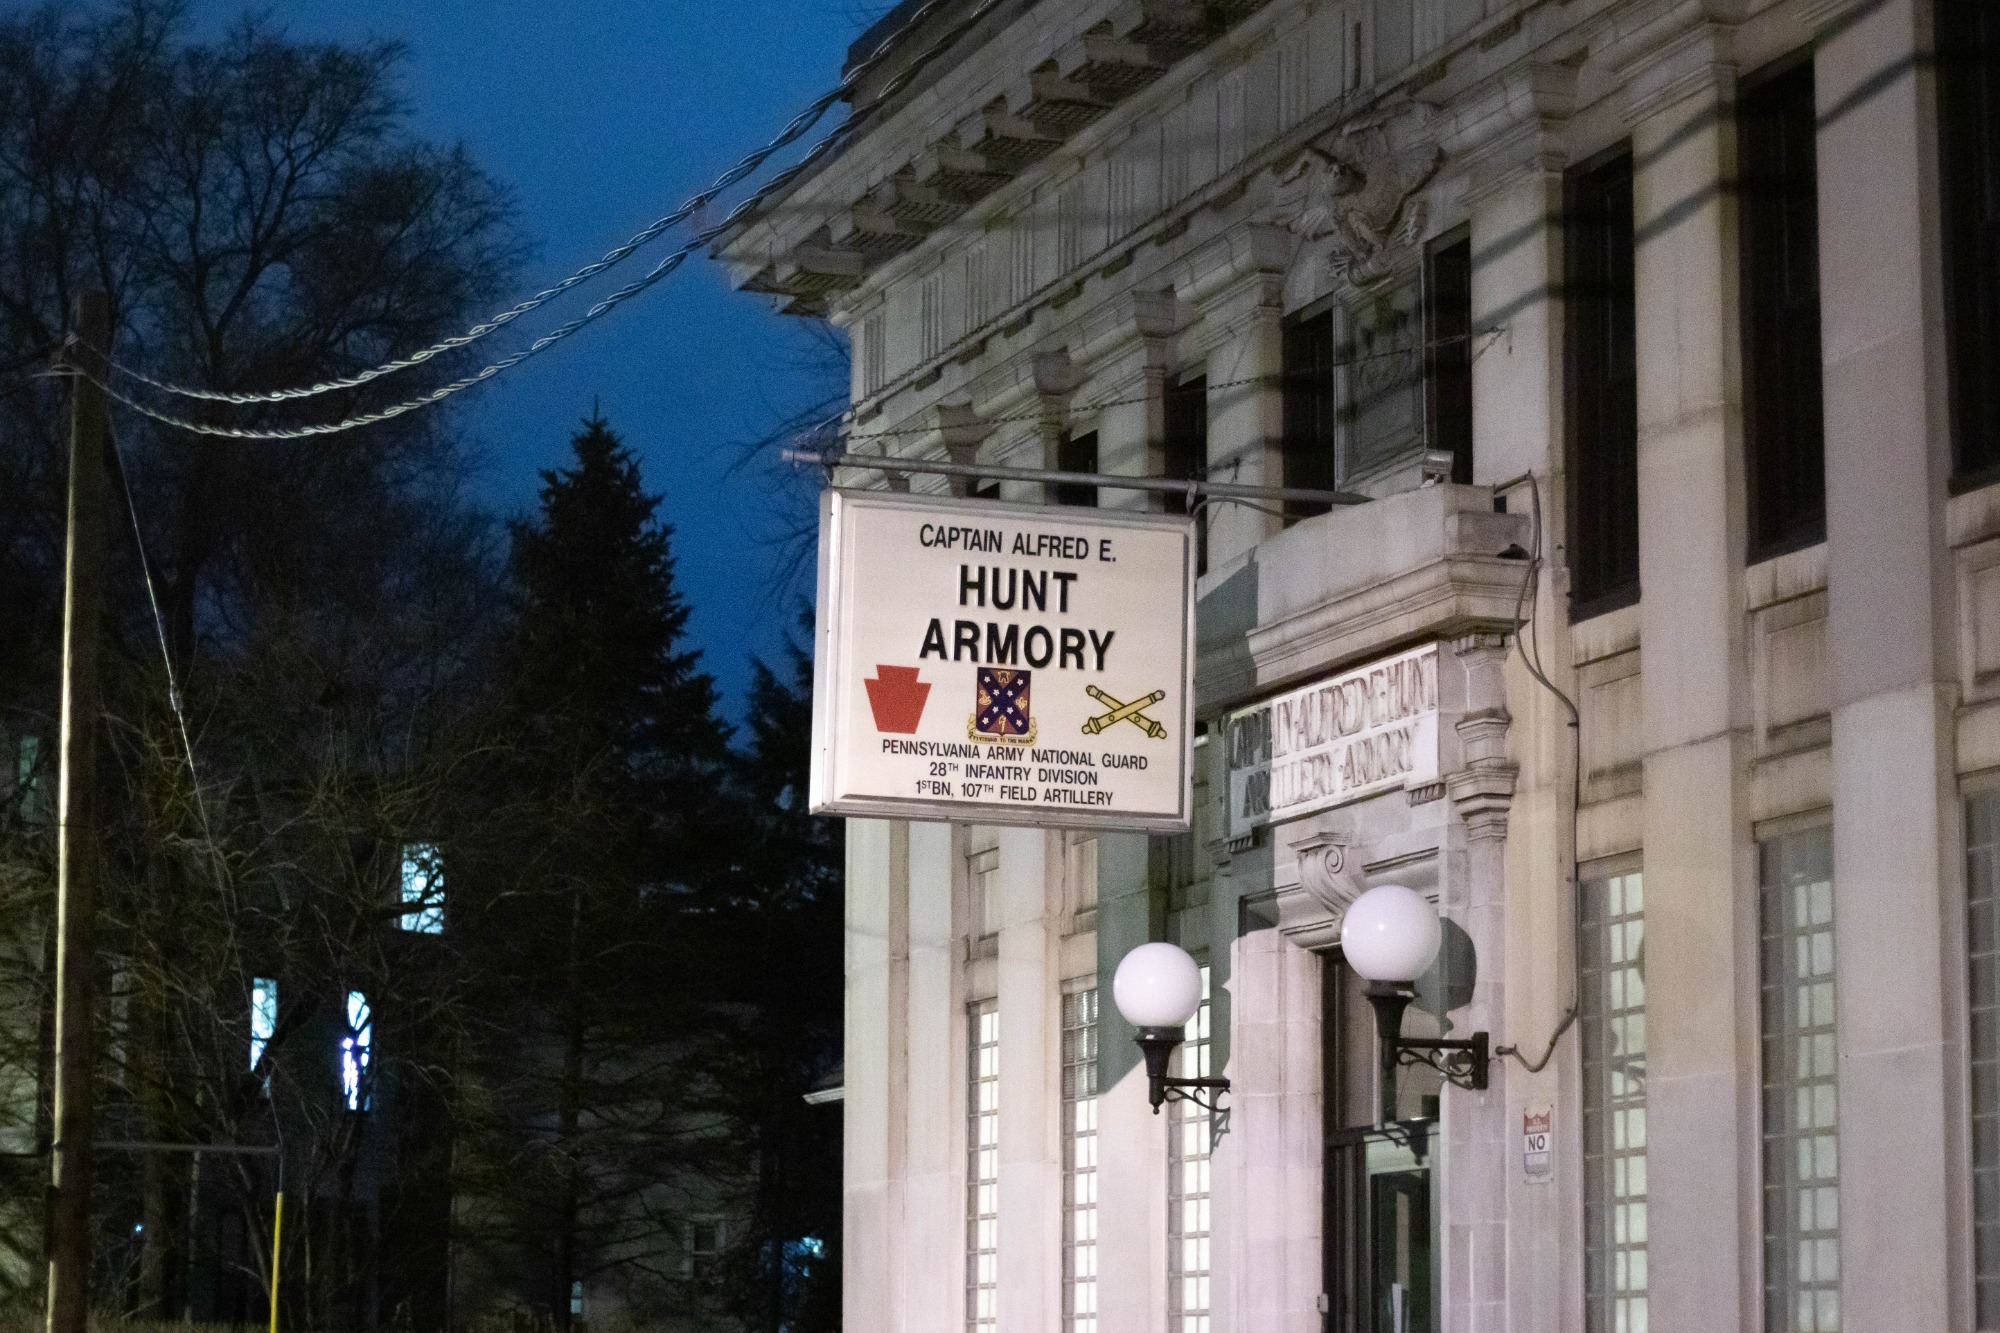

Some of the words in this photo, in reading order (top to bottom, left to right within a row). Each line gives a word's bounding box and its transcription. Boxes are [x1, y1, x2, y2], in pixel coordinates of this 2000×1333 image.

[919, 523, 1003, 554] CAPTAIN
[1011, 532, 1090, 560] ALFRED
[1099, 539, 1117, 563] E.
[959, 564, 1078, 613] HUNT
[919, 618, 1115, 671] ARMORY
[882, 738, 980, 759] PENNSYLVANIA
[986, 745, 1025, 762] ARMY
[1031, 748, 1096, 767] NATIONAL
[1101, 753, 1148, 770] GUARD
[929, 761, 959, 777] 28TH
[965, 763, 1032, 781] INFANTRY
[1038, 768, 1098, 786] DIVISION
[961, 782, 994, 798] 107TH
[1000, 785, 1037, 801] FIELD
[1043, 788, 1114, 806] ARTILLERY
[1528, 1134, 1546, 1152] NO
